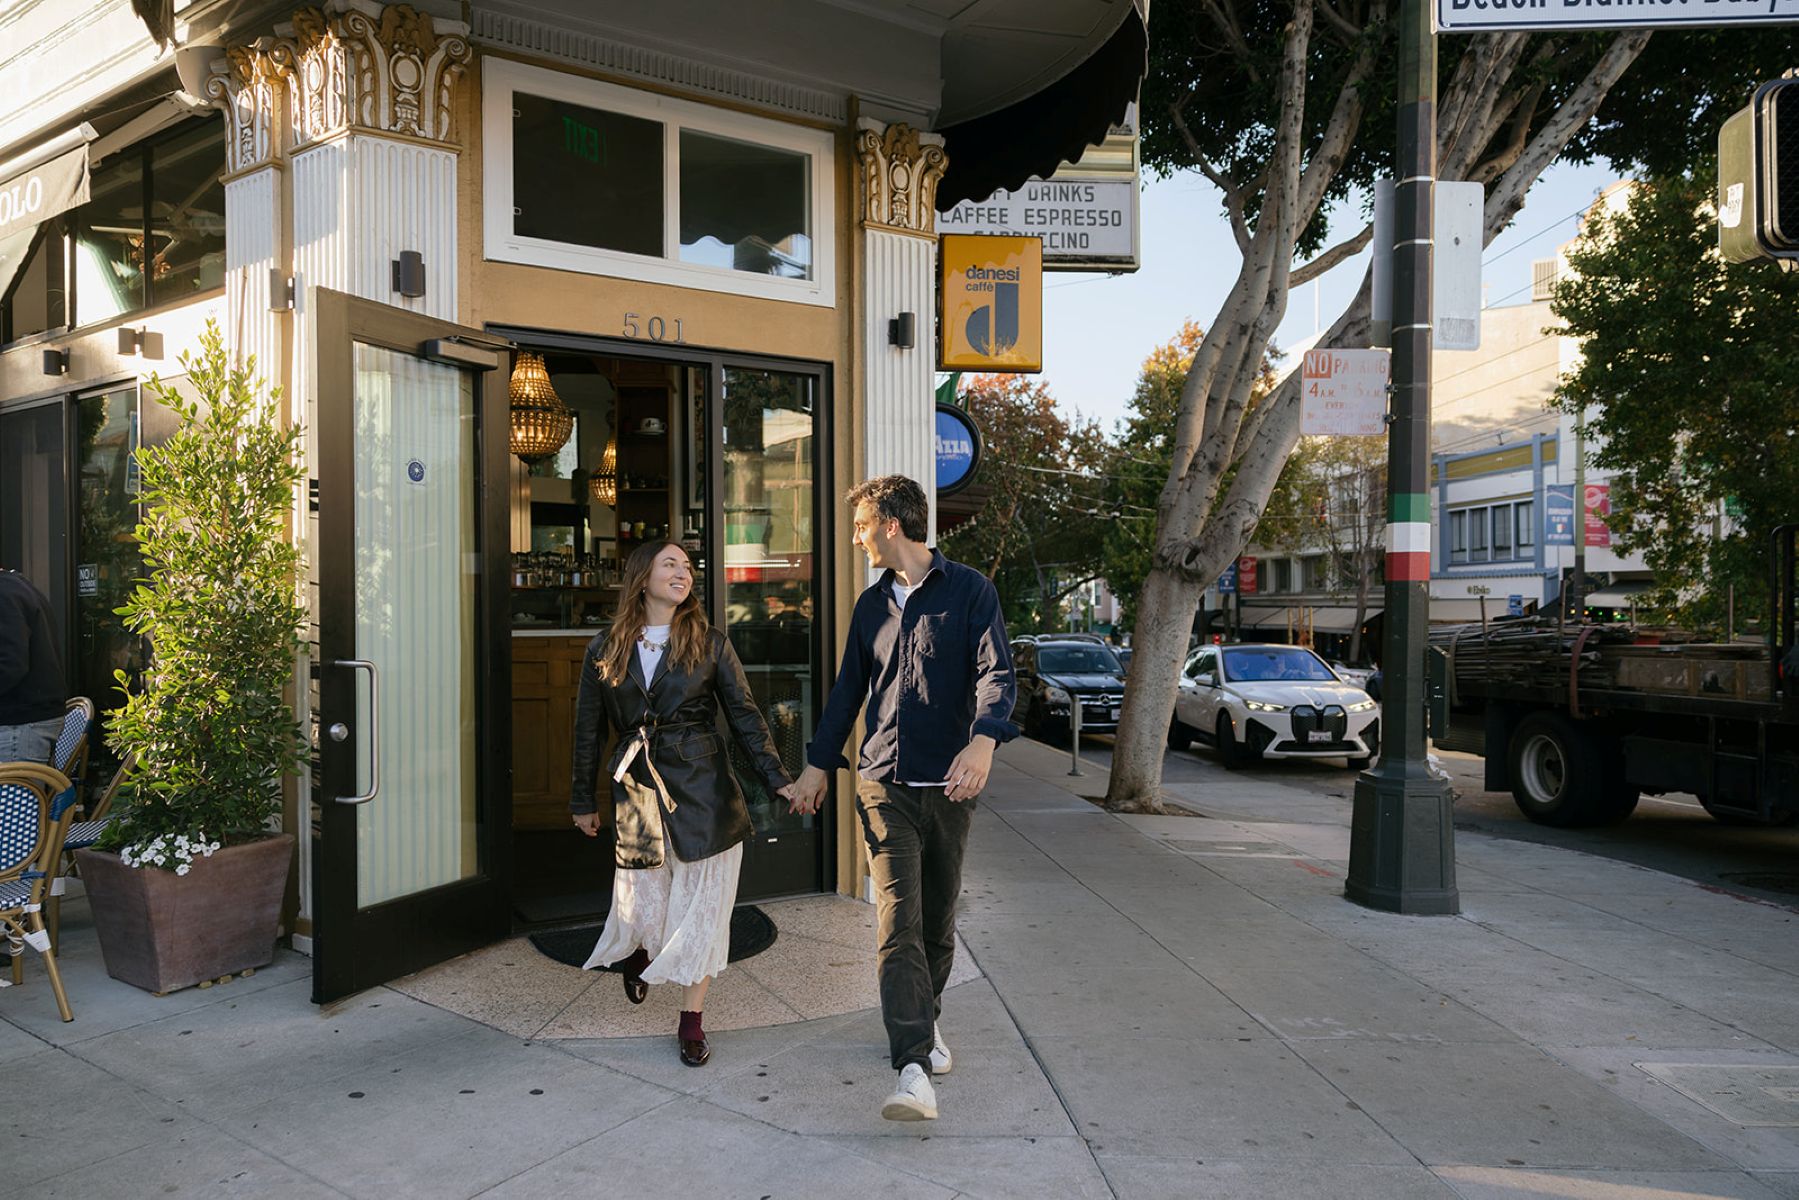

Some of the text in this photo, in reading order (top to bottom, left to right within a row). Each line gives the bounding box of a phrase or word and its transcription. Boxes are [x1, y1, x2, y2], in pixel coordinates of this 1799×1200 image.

[1028, 185, 1095, 203] DRINKS
[1024, 208, 1122, 227] ESPRESSO
[966, 265, 1020, 281] danesi
[622, 312, 687, 345] 501
[1306, 352, 1330, 375] NO
